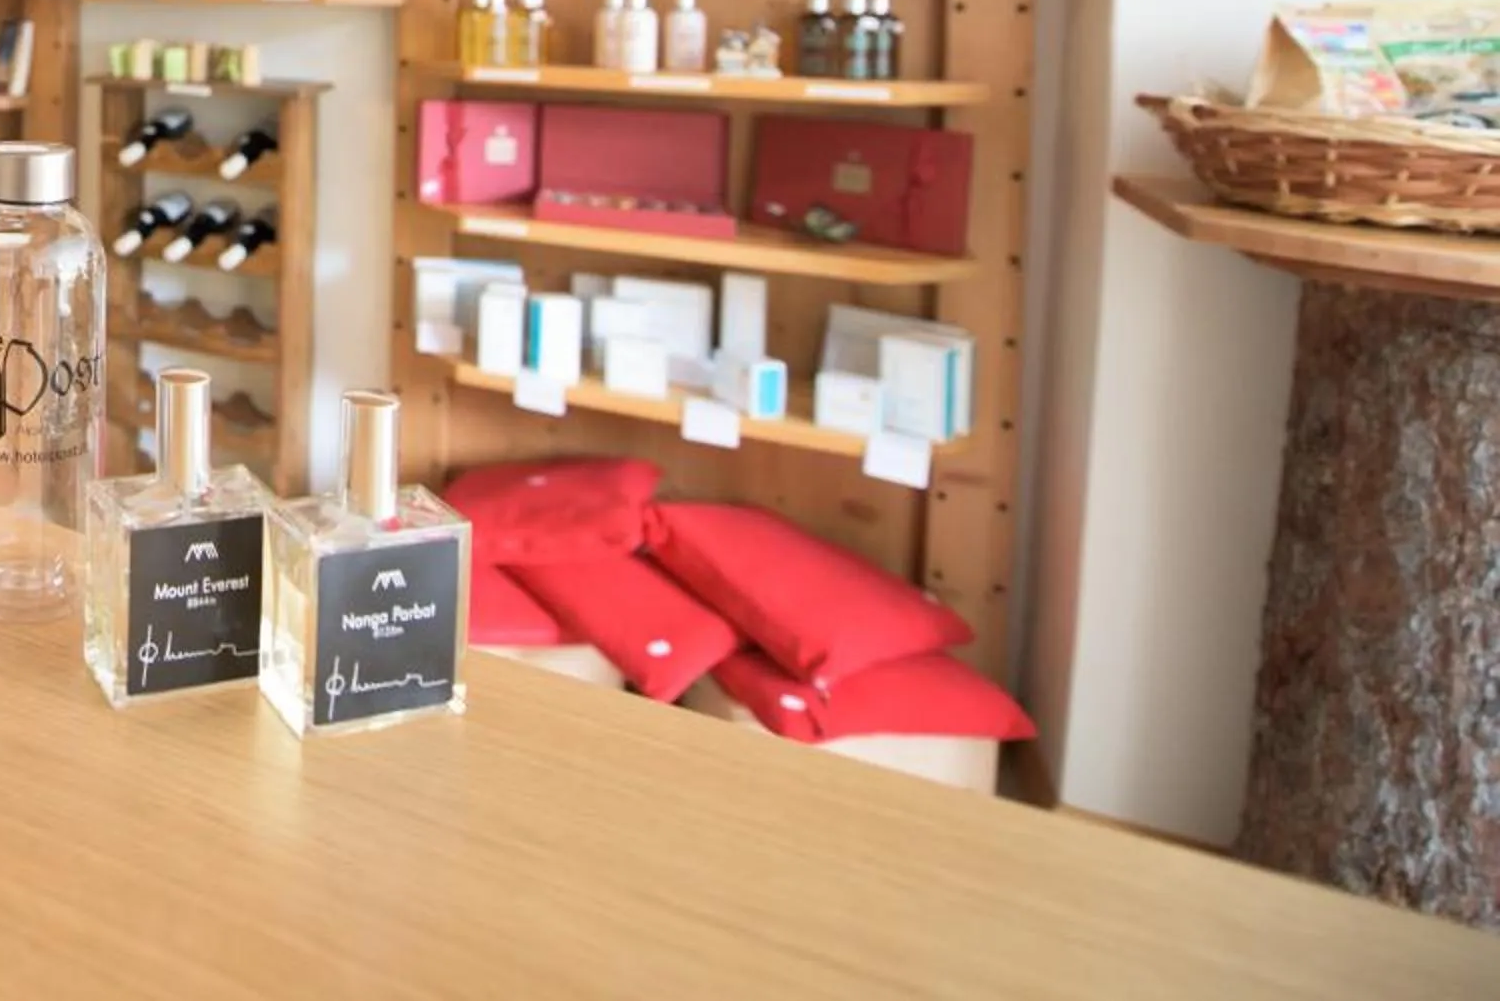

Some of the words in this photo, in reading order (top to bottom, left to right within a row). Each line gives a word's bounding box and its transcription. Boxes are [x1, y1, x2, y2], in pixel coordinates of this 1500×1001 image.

[153, 578, 200, 601] Mount
[202, 574, 250, 595] Everest
[341, 609, 388, 631] Nanga
[392, 601, 437, 622] Parbat
